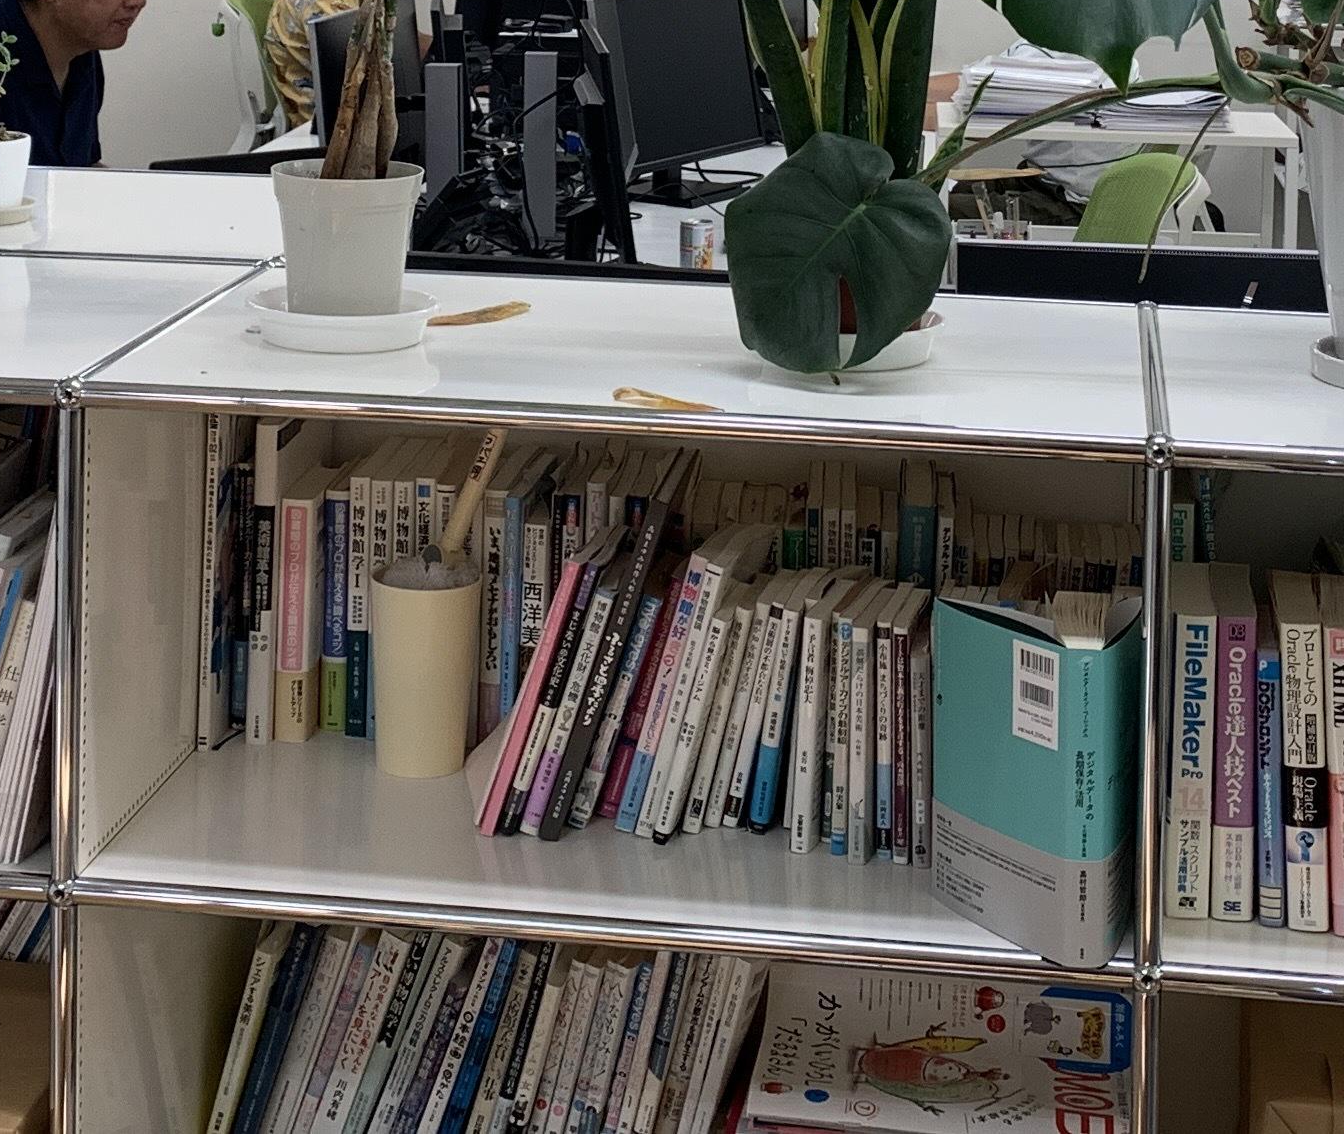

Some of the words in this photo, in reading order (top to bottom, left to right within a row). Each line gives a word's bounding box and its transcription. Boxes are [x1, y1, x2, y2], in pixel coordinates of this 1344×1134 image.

[396, 505, 410, 558] 博物館
[1172, 509, 1188, 563] Facebo
[837, 641, 851, 745] デジタルアーカイブの最前線
[1182, 624, 1210, 769] FileMaker
[1303, 628, 1318, 707] プロとしての
[1224, 646, 1248, 819] Oracle達人技ベスト
[1085, 750, 1096, 822] デジタルデータの
[1178, 787, 1206, 808] 14
[1181, 769, 1204, 780] Pro
[1303, 777, 1318, 823] Oracle
[1052, 1057, 1115, 1134] MOE
